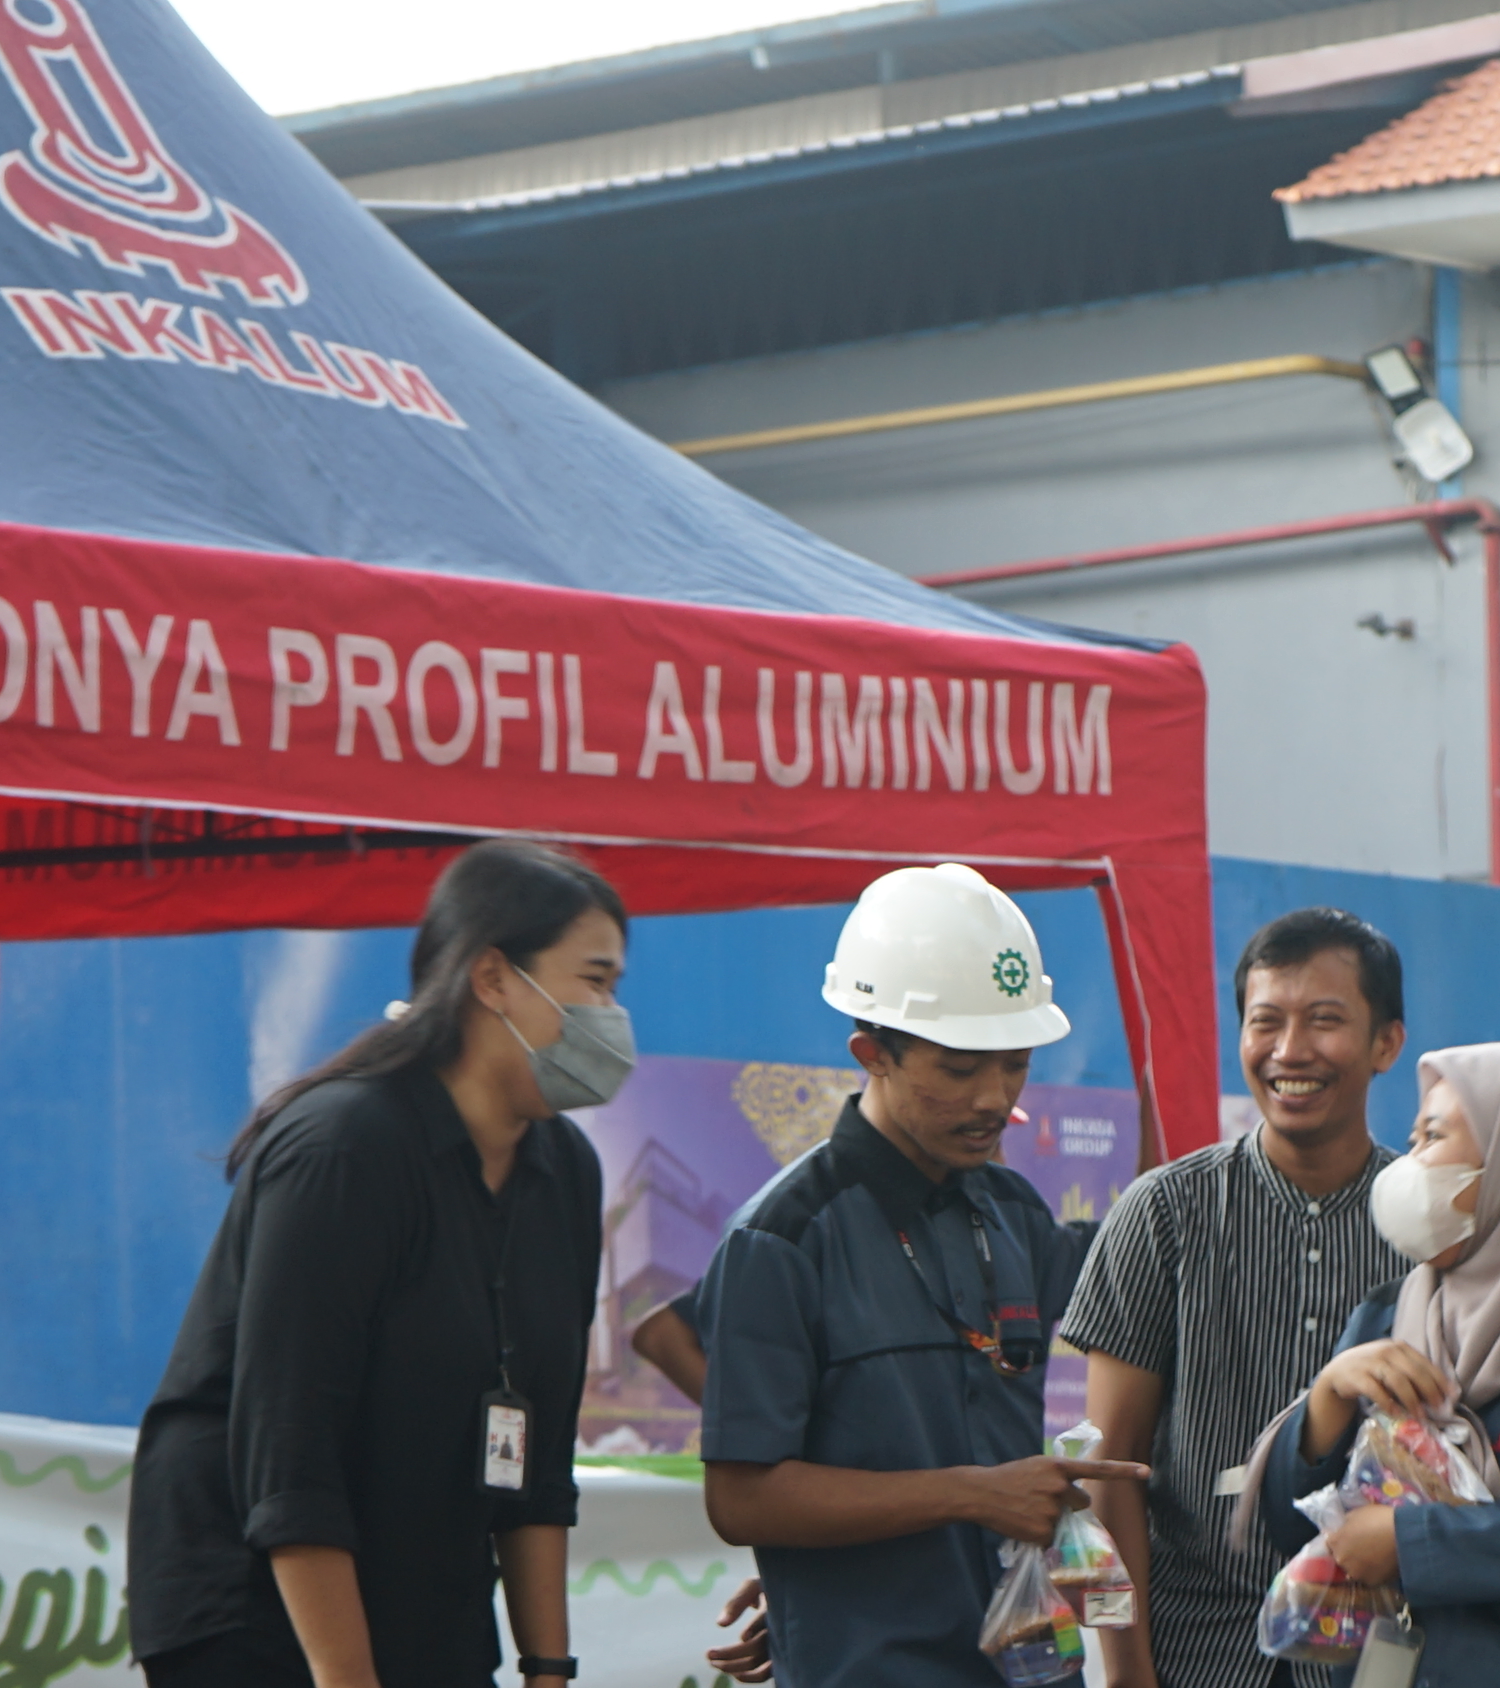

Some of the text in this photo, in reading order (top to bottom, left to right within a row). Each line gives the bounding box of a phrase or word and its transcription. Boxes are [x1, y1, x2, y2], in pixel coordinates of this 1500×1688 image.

[0, 287, 467, 429] INKALUM
[271, 627, 618, 776] PROFIL
[637, 661, 1112, 795] ALUMINIUM
